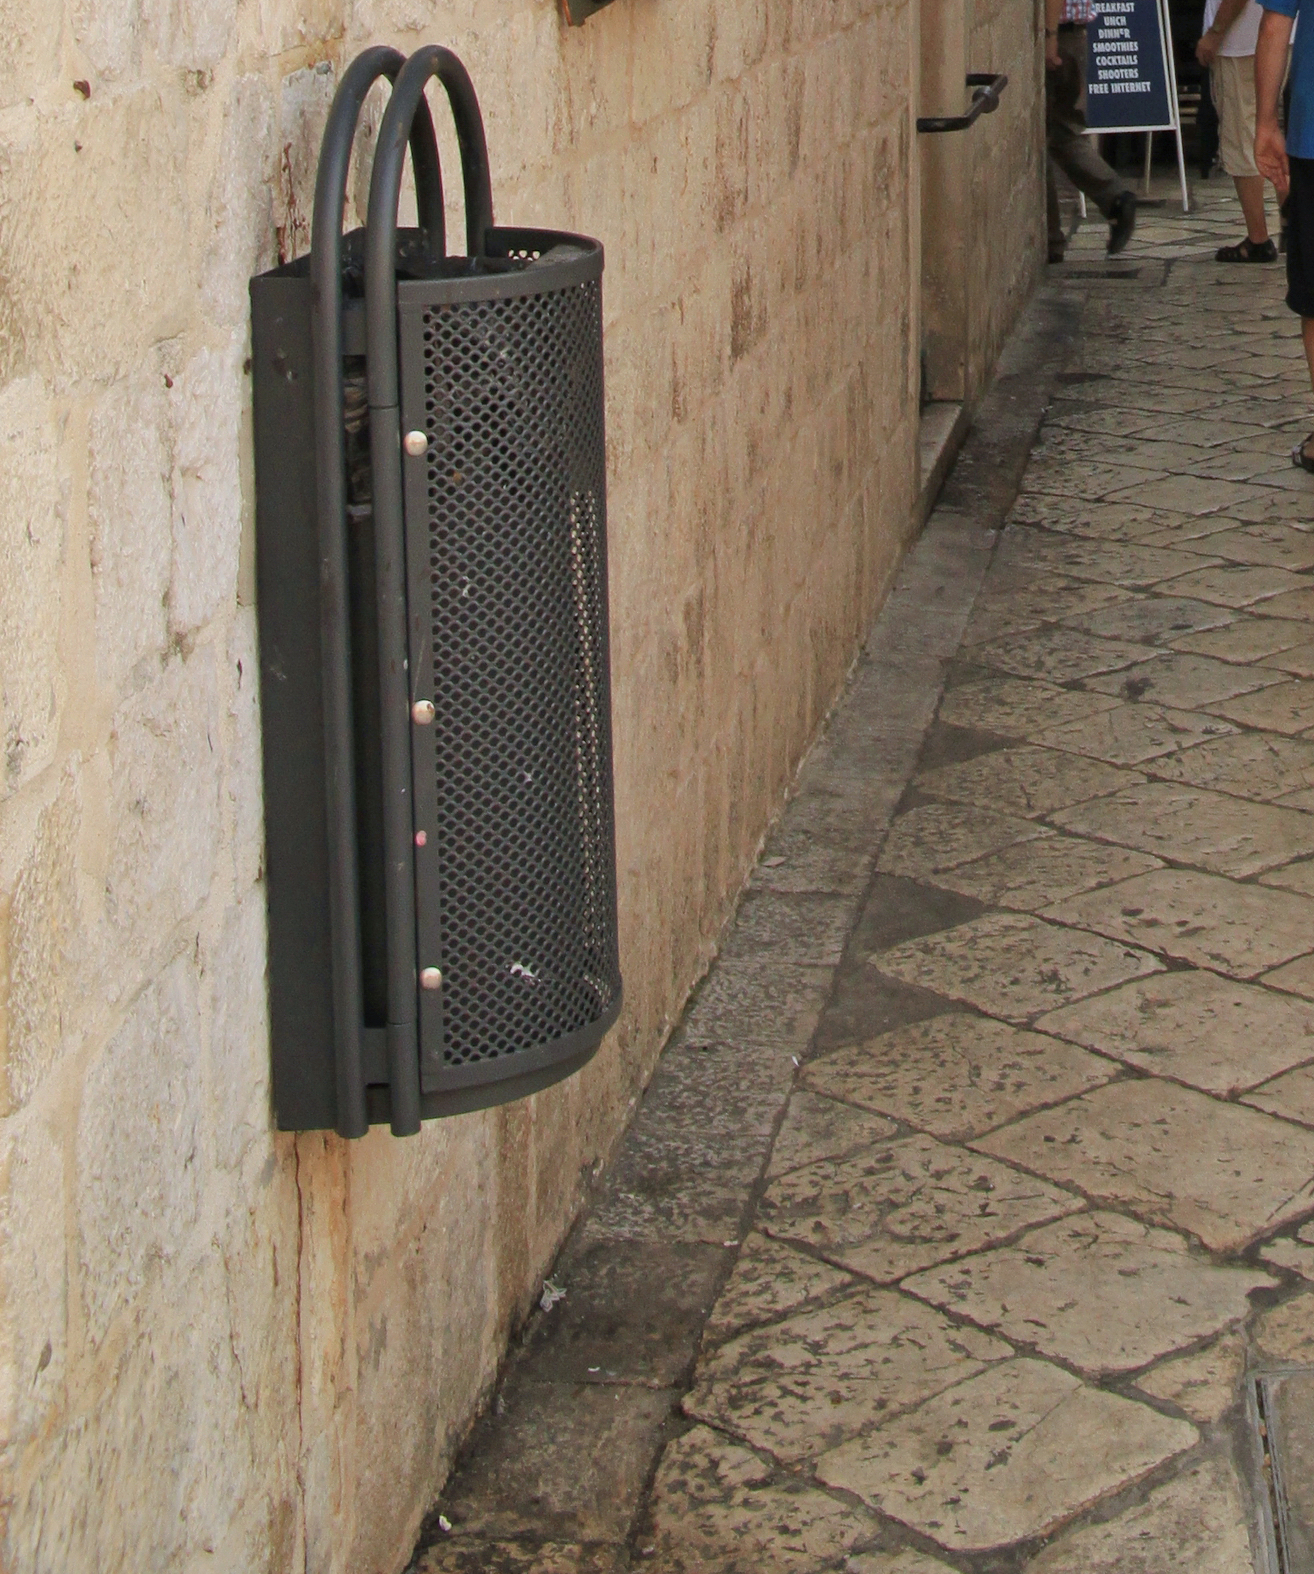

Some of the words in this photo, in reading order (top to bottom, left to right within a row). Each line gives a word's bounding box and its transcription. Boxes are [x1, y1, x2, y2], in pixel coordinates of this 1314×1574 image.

[1095, 2, 1135, 13] REAKFAST
[1092, 41, 1139, 53] SMOOTHIES
[1095, 55, 1138, 66] COCKTAILS
[1097, 68, 1139, 80] SHOOTERS
[1088, 83, 1109, 94] FREE
[1110, 81, 1151, 93] INTERNET
